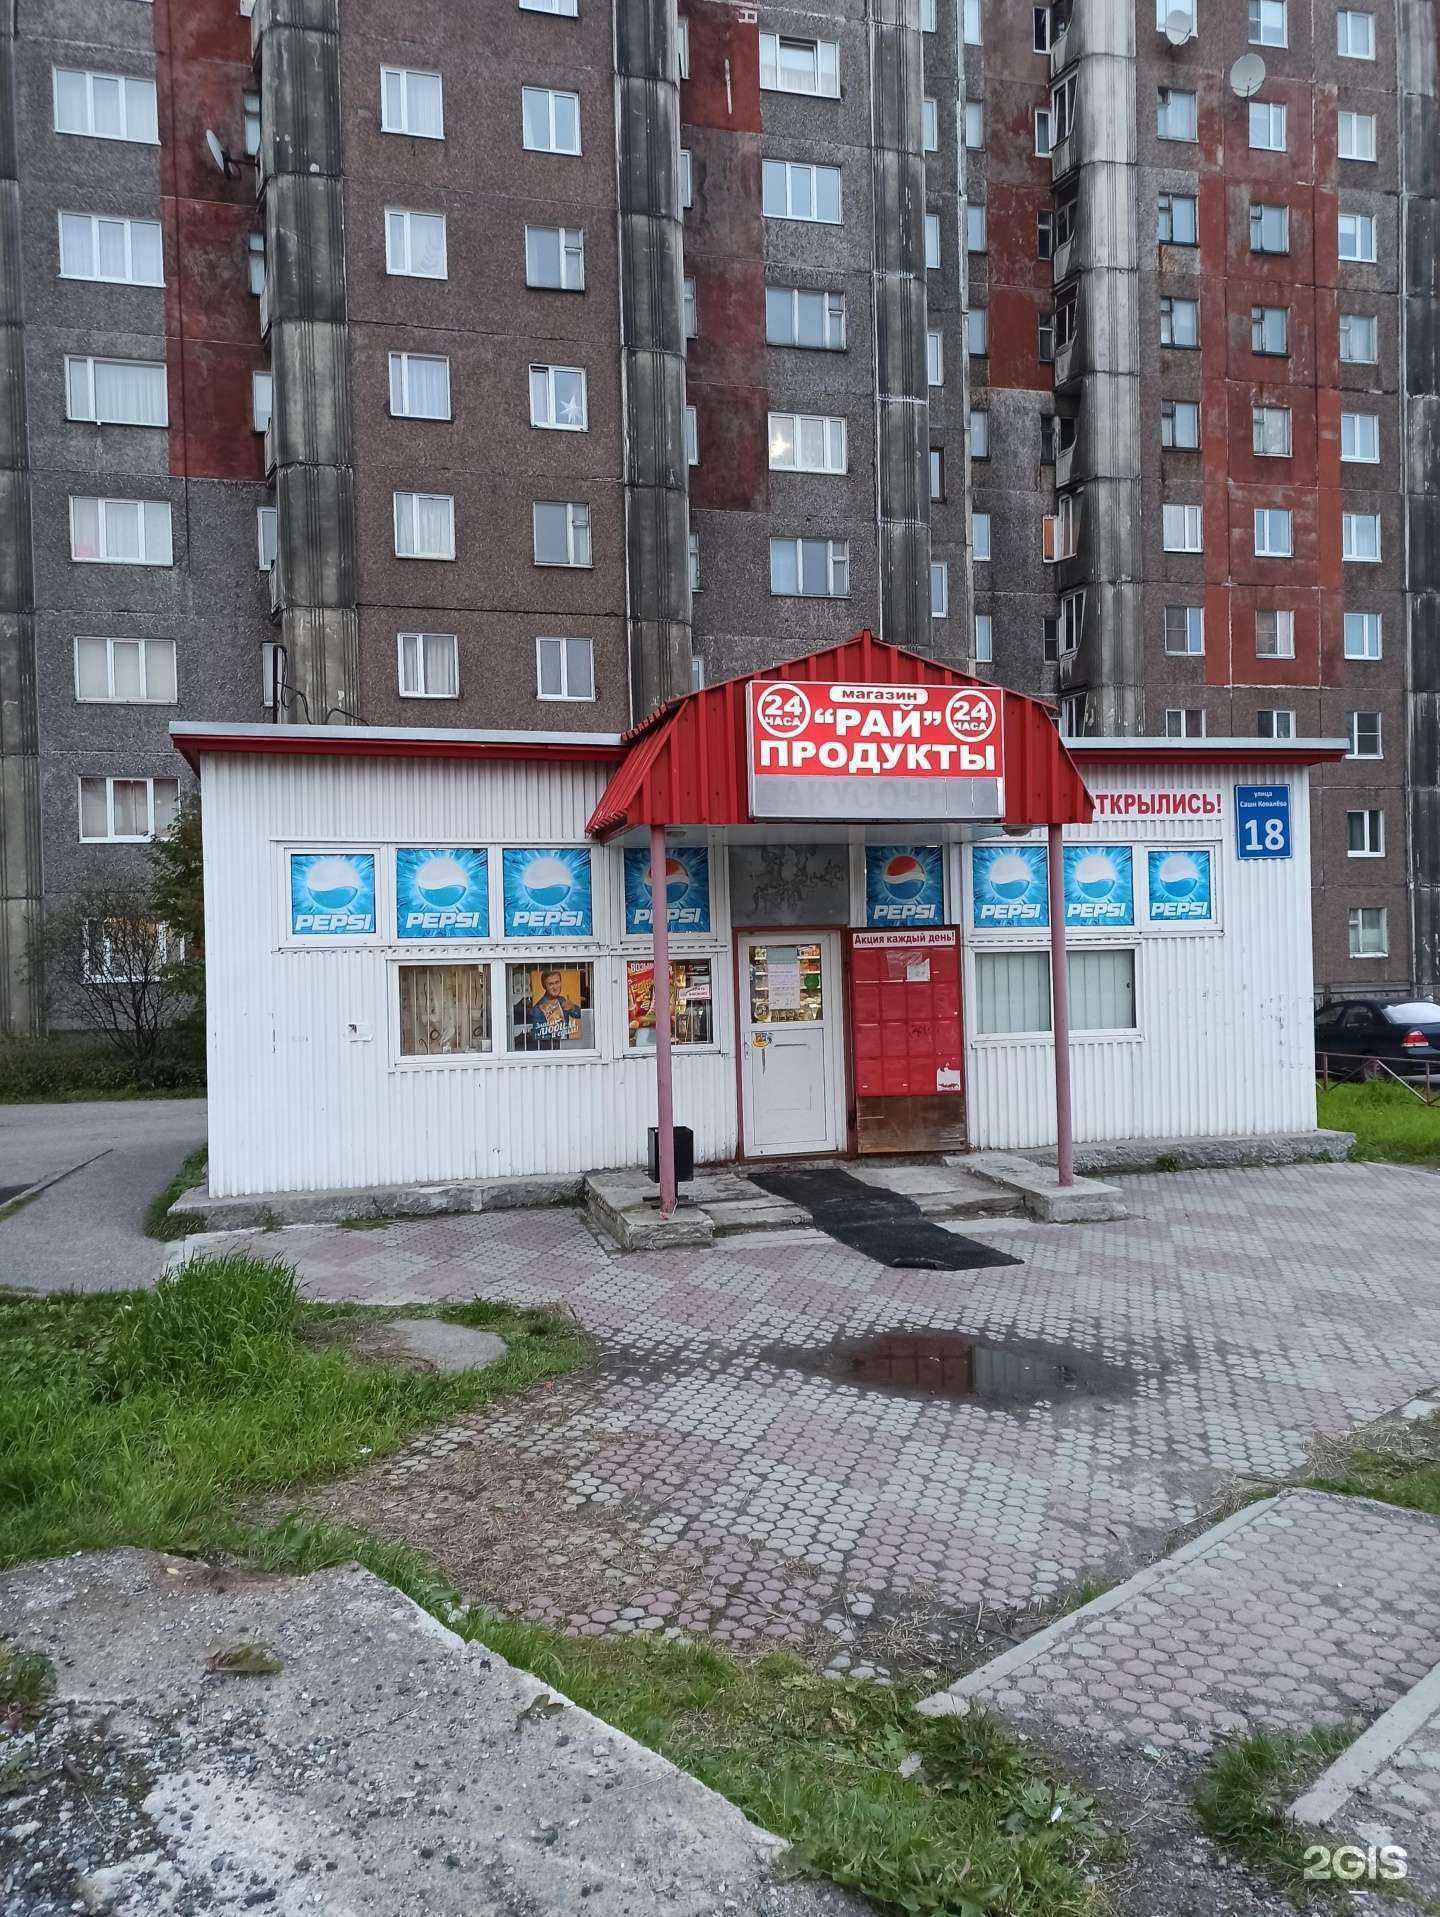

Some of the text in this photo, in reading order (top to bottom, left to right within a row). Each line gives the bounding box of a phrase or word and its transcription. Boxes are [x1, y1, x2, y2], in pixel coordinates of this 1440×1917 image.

[841, 688, 918, 702] магазин
[763, 695, 803, 716] 24
[952, 701, 989, 719] 24
[765, 716, 801, 727] ЧАСА
[953, 721, 988, 731] ЧАСА
[760, 740, 996, 774] ПРОДУКТЫ
[1091, 793, 1222, 815] ТКРЫЛИСЬ!
[1245, 818, 1285, 851] 18
[633, 908, 702, 925] PPSI
[873, 904, 935, 920] PEPSI
[980, 903, 1041, 919] PEPSI
[1067, 902, 1126, 918] PEPSI
[1151, 901, 1208, 917] PEPSI
[295, 913, 372, 931] PEPSI
[405, 911, 478, 929] PEPSI
[512, 910, 583, 928] PEPSI
[854, 931, 955, 945] Акция каждый день!
